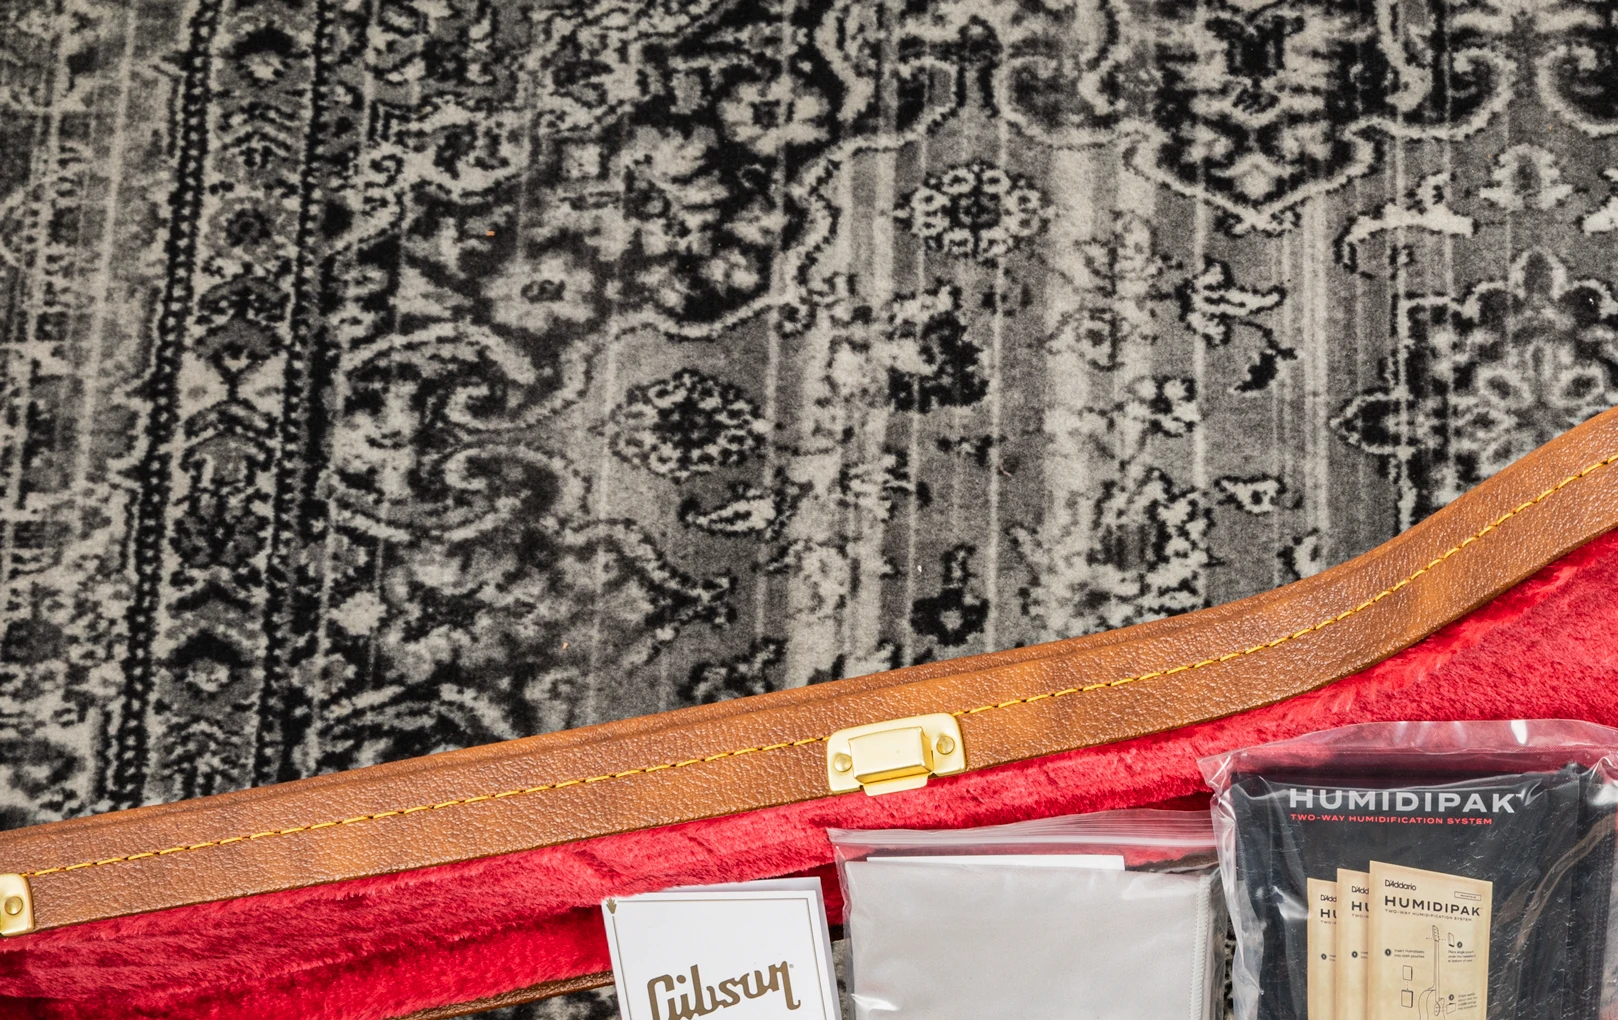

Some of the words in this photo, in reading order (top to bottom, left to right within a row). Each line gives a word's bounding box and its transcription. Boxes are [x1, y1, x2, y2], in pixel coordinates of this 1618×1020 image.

[1289, 787, 1515, 813] HUMIDIPAK
[1290, 813, 1345, 822] TWO-WAY
[1349, 815, 1443, 825] HUMIDIFICATION
[1447, 817, 1493, 825] SYSTEM
[1384, 879, 1417, 891] D'Addario
[1384, 895, 1481, 917] HUMIDIPAK
